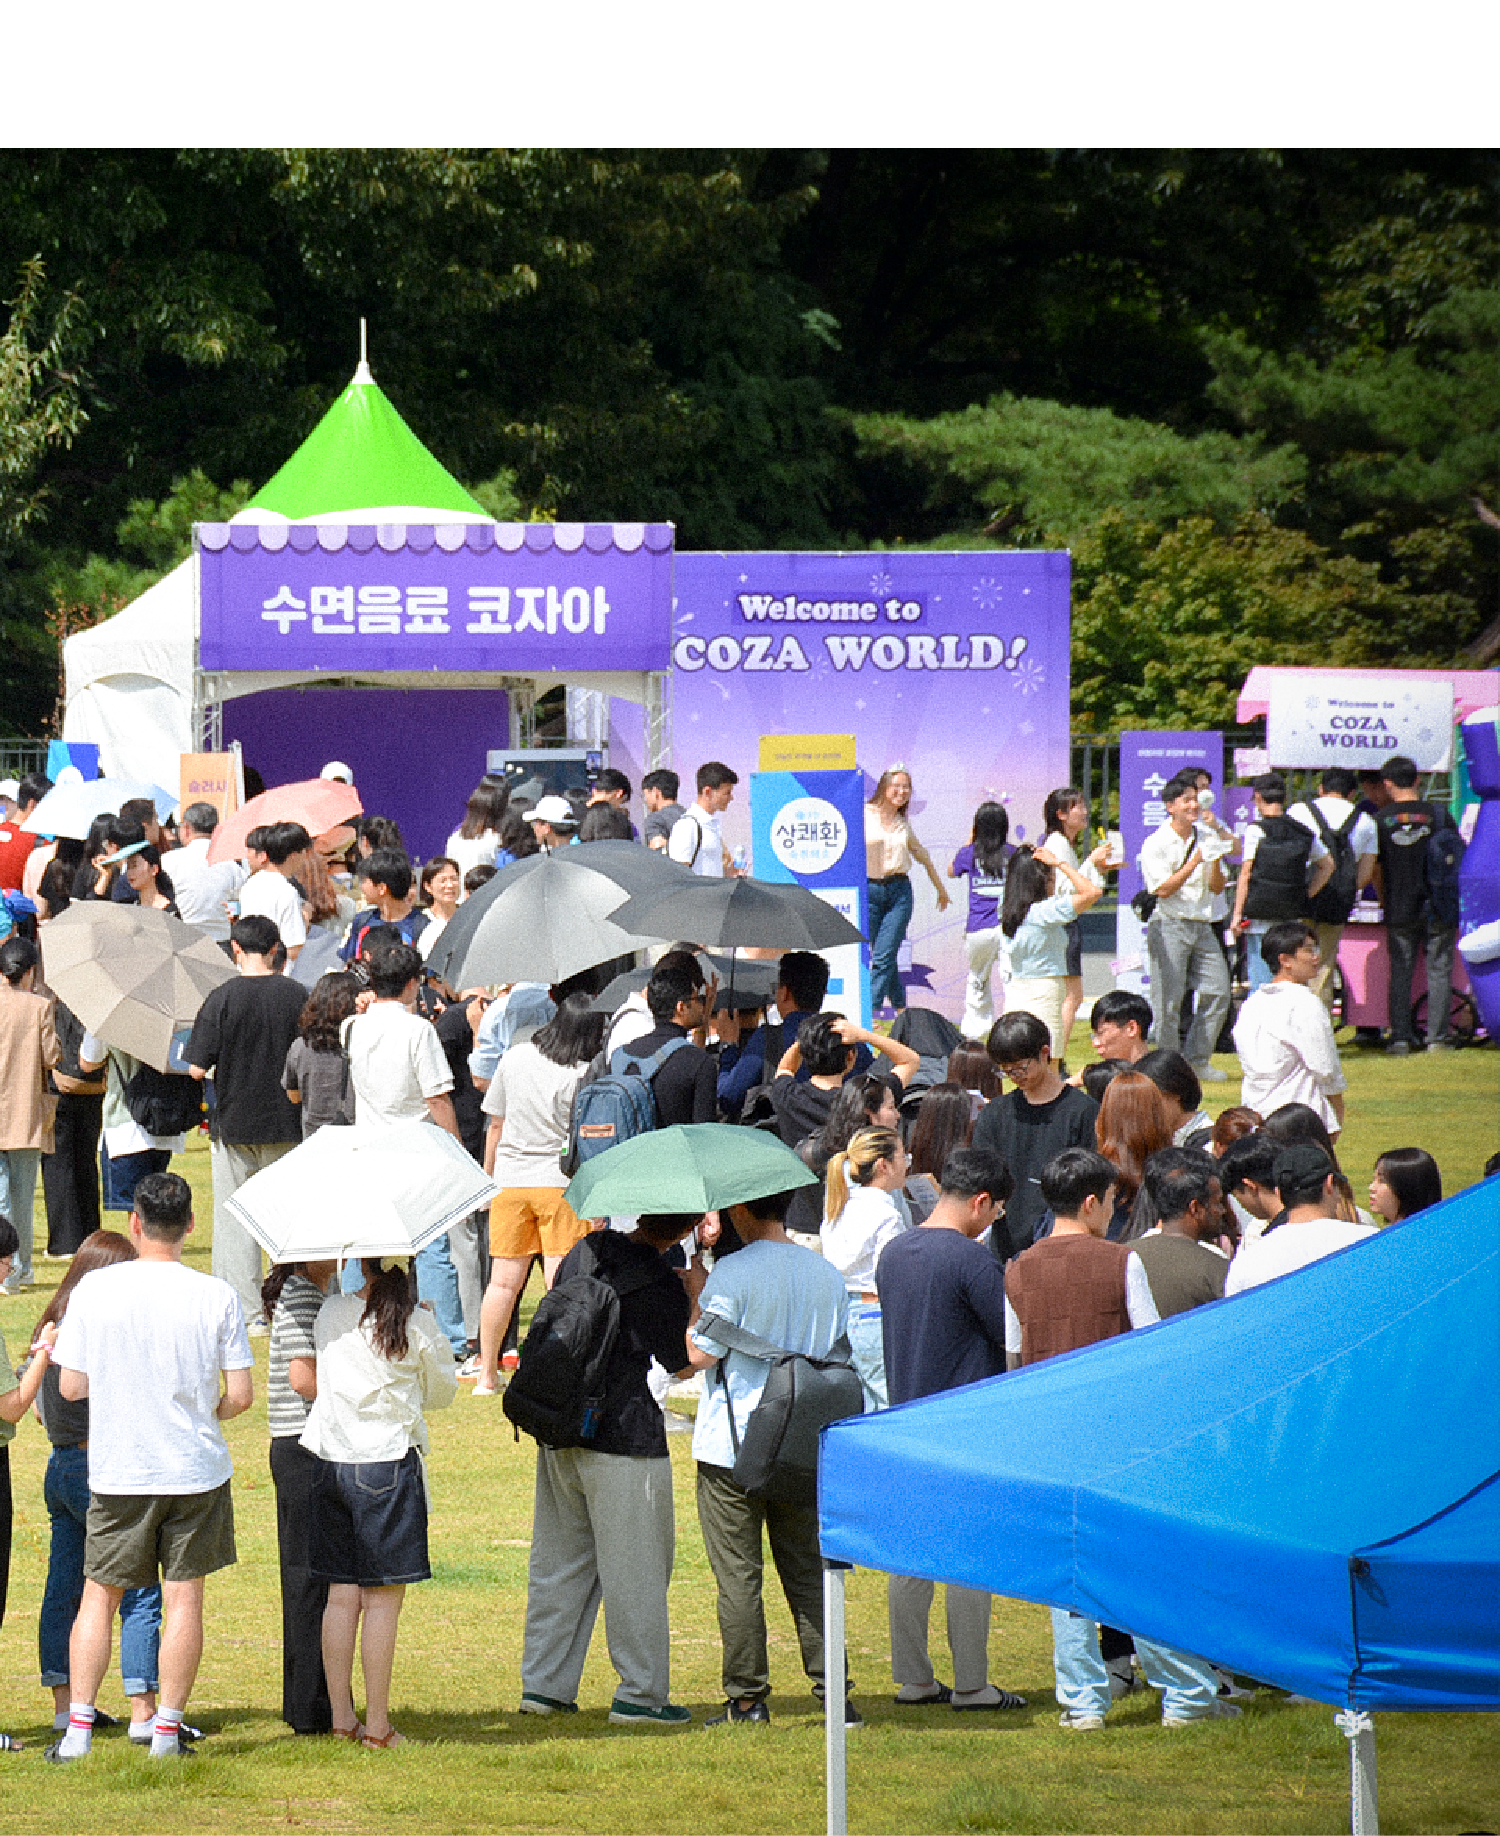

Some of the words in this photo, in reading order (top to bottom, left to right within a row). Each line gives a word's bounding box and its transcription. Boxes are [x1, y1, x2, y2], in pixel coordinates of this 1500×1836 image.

[261, 585, 452, 635] 수면음료
[465, 585, 610, 635] 코자아
[737, 593, 879, 623] Welcome
[884, 597, 921, 623] to
[673, 634, 812, 672] COZA
[822, 634, 1028, 672] WORLD!
[1330, 716, 1388, 731] COZA
[1320, 732, 1399, 749] WORLD
[189, 779, 228, 794] 슬러시
[776, 820, 842, 849] 상쾌환
